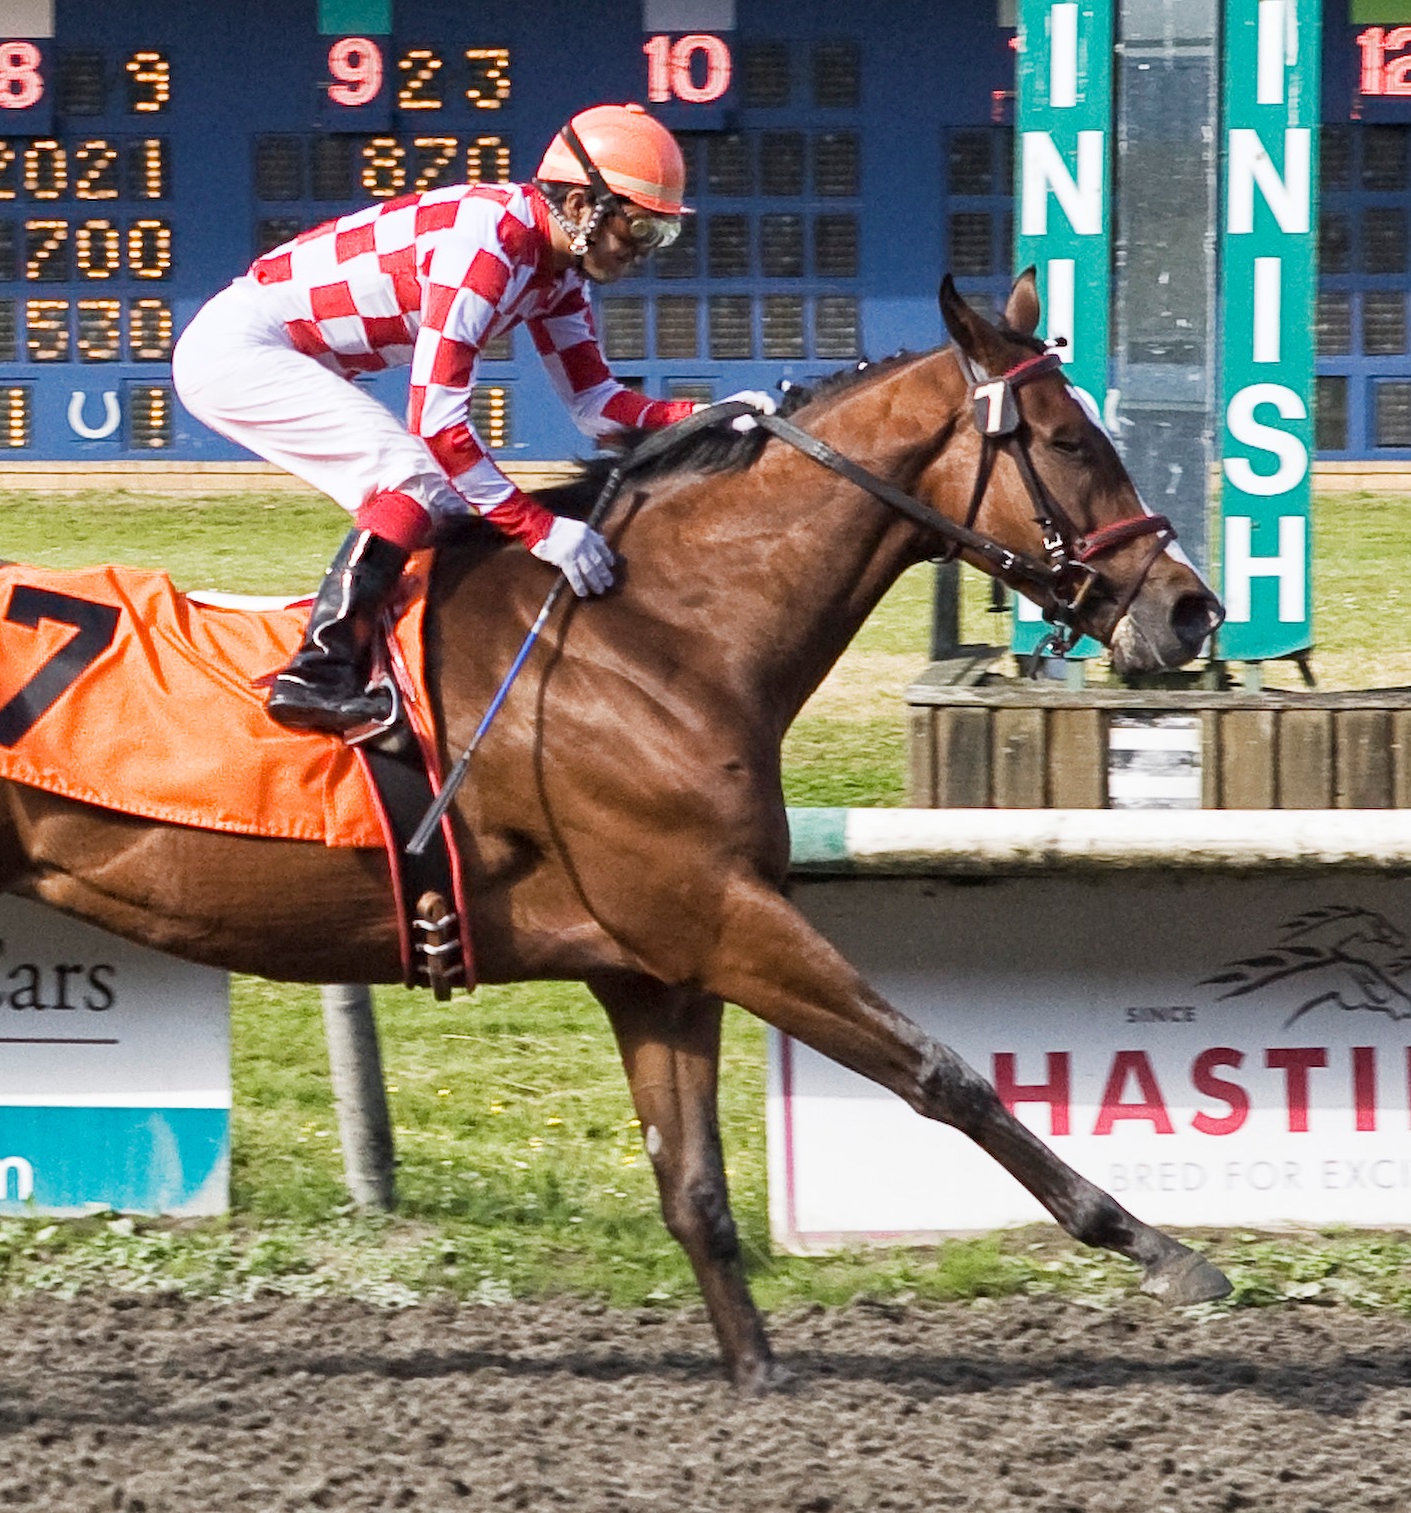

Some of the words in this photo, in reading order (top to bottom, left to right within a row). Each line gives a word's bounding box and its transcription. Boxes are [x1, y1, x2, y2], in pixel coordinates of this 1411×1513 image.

[127, 53, 171, 112] 9
[329, 38, 384, 107] 9
[643, 35, 733, 105] 10
[363, 137, 511, 197] 870
[26, 220, 172, 280] 700
[27, 300, 174, 360] 530
[973, 380, 1006, 434] 7
[1125, 1005, 1197, 1024] SINCE
[993, 1046, 1411, 1136] HASTI
[1110, 1162, 1209, 1192] BRED
[1225, 1160, 1304, 1190] FOR
